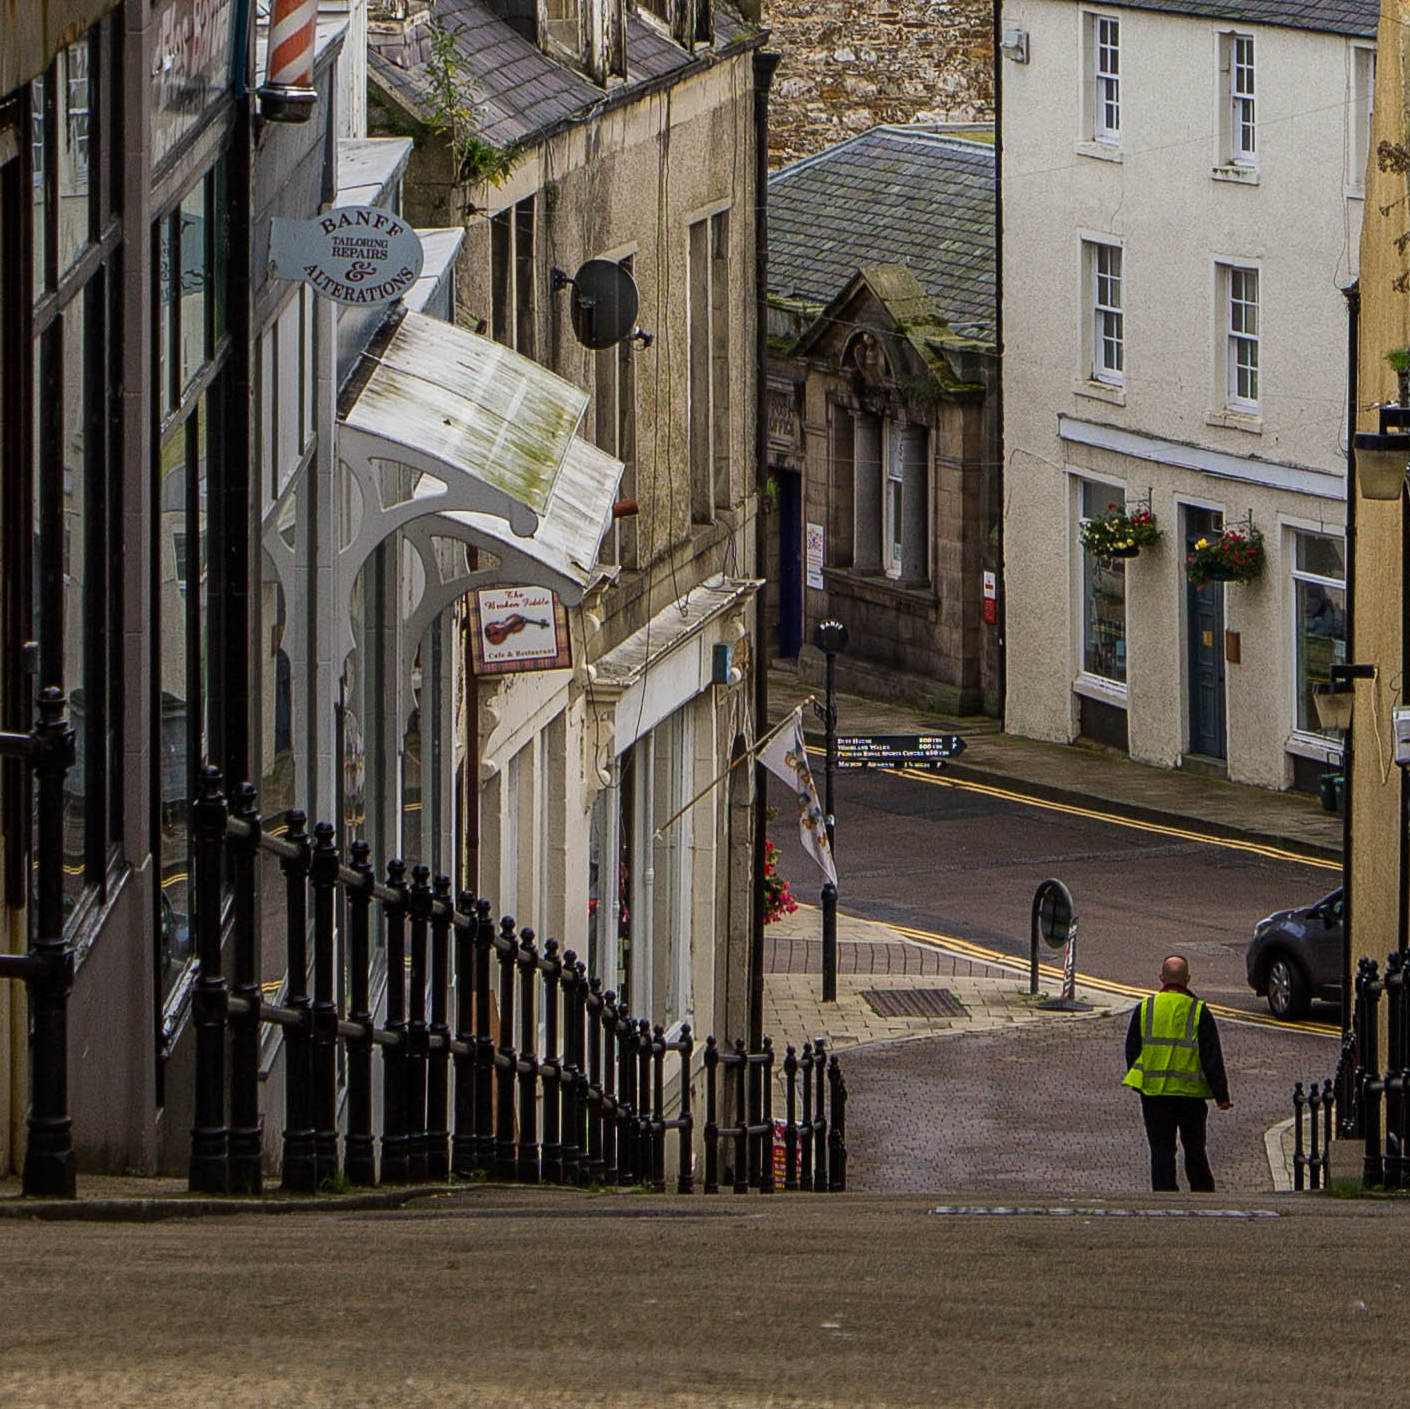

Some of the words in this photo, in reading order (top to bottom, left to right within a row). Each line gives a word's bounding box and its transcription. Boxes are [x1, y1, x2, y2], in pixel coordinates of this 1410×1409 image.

[319, 210, 404, 237] BANFF
[331, 236, 389, 249] TAILORING
[331, 247, 388, 261] REPAIRS
[345, 261, 377, 282] &
[303, 264, 414, 303] ALTERATIONS
